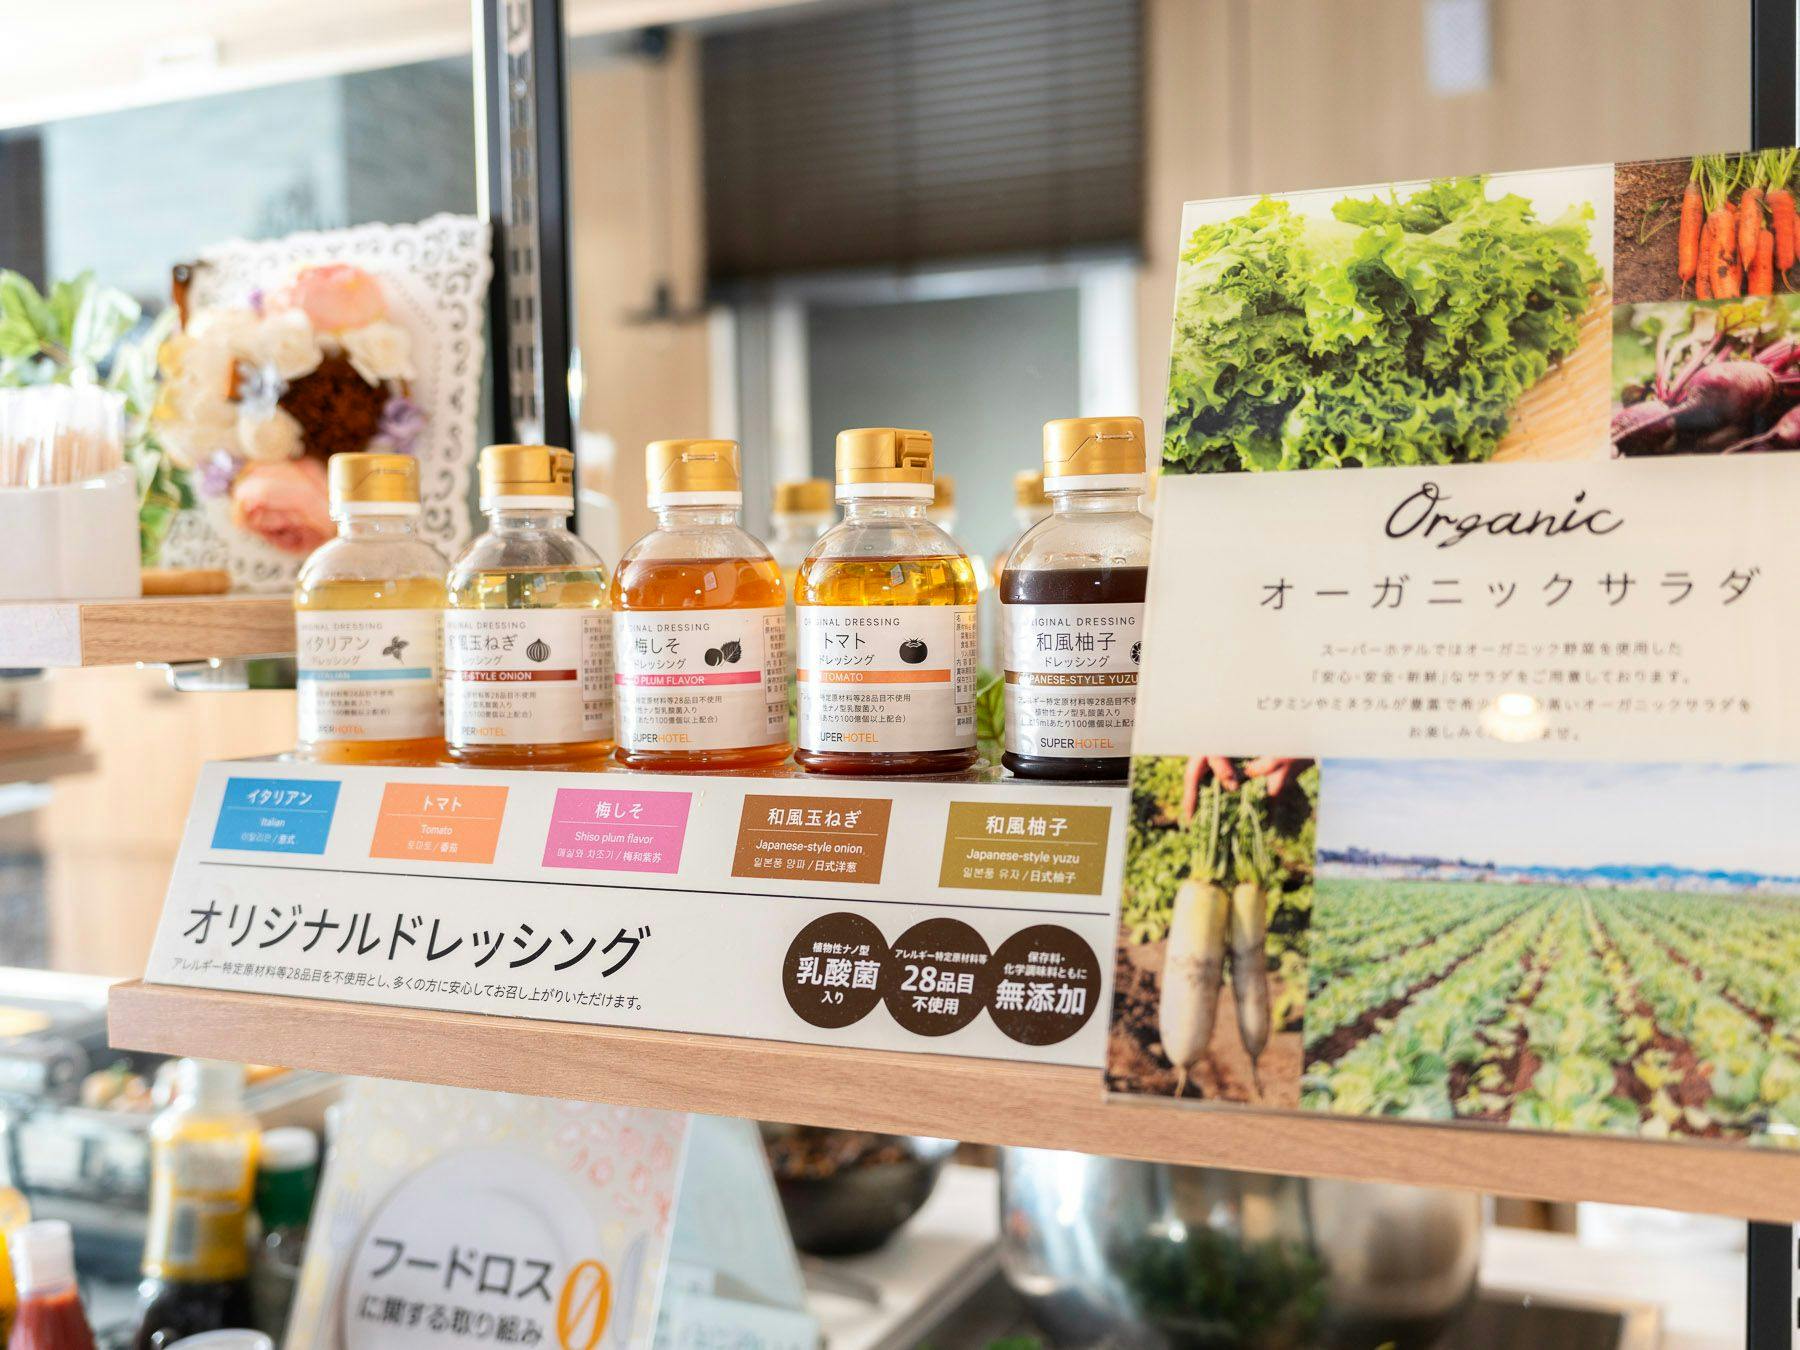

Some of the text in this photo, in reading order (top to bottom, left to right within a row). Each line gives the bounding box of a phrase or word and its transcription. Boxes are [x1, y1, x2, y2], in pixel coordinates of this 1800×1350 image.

[1385, 481, 1625, 549] Organic
[1260, 565, 1761, 610] オーガニックサラダ
[477, 621, 526, 630] DRESSING
[657, 622, 710, 632] DRESSING
[845, 617, 900, 626] DRESSING
[1077, 616, 1136, 626] DRESSING
[635, 637, 680, 655] 梅しそ
[824, 632, 866, 649] トマト
[1036, 632, 1116, 652] 和風柚子
[1044, 655, 1110, 668] ドレッシング
[499, 671, 532, 681] ONION
[640, 676, 664, 686] PLUM
[666, 675, 705, 685] FLAVOR
[823, 671, 863, 682] TOMATO
[1109, 673, 1138, 685] YUZU
[820, 731, 879, 743] UPERHOTEL
[1040, 737, 1115, 749] SUPERHOTEL
[247, 789, 313, 806] イタリアン
[423, 794, 463, 812] トマト
[594, 801, 644, 819] 梅しそ
[767, 807, 863, 828] 和風玉ねぎ
[261, 816, 286, 828] Italian
[421, 823, 453, 836] Tomato
[985, 815, 1068, 837] 和風柚子
[575, 831, 655, 844] Shiso plum flavor
[756, 839, 864, 854] Japanese-style onion
[966, 848, 1080, 865] Japanese-style yuzu
[183, 899, 652, 978] オリジナルドレッシング
[812, 941, 870, 956] 植物性ナノ型
[894, 949, 989, 965] アレルギー特定原材料等
[796, 956, 881, 991] 乳酸菌
[901, 965, 975, 995] 28品目
[1004, 963, 1088, 981] 化学調味料ともに
[821, 990, 844, 1005] 入り
[912, 996, 960, 1016] 不使用
[995, 979, 1087, 1016] 無添加
[370, 1237, 556, 1303] フードロス
[358, 1294, 543, 1346] に関する取り組み
